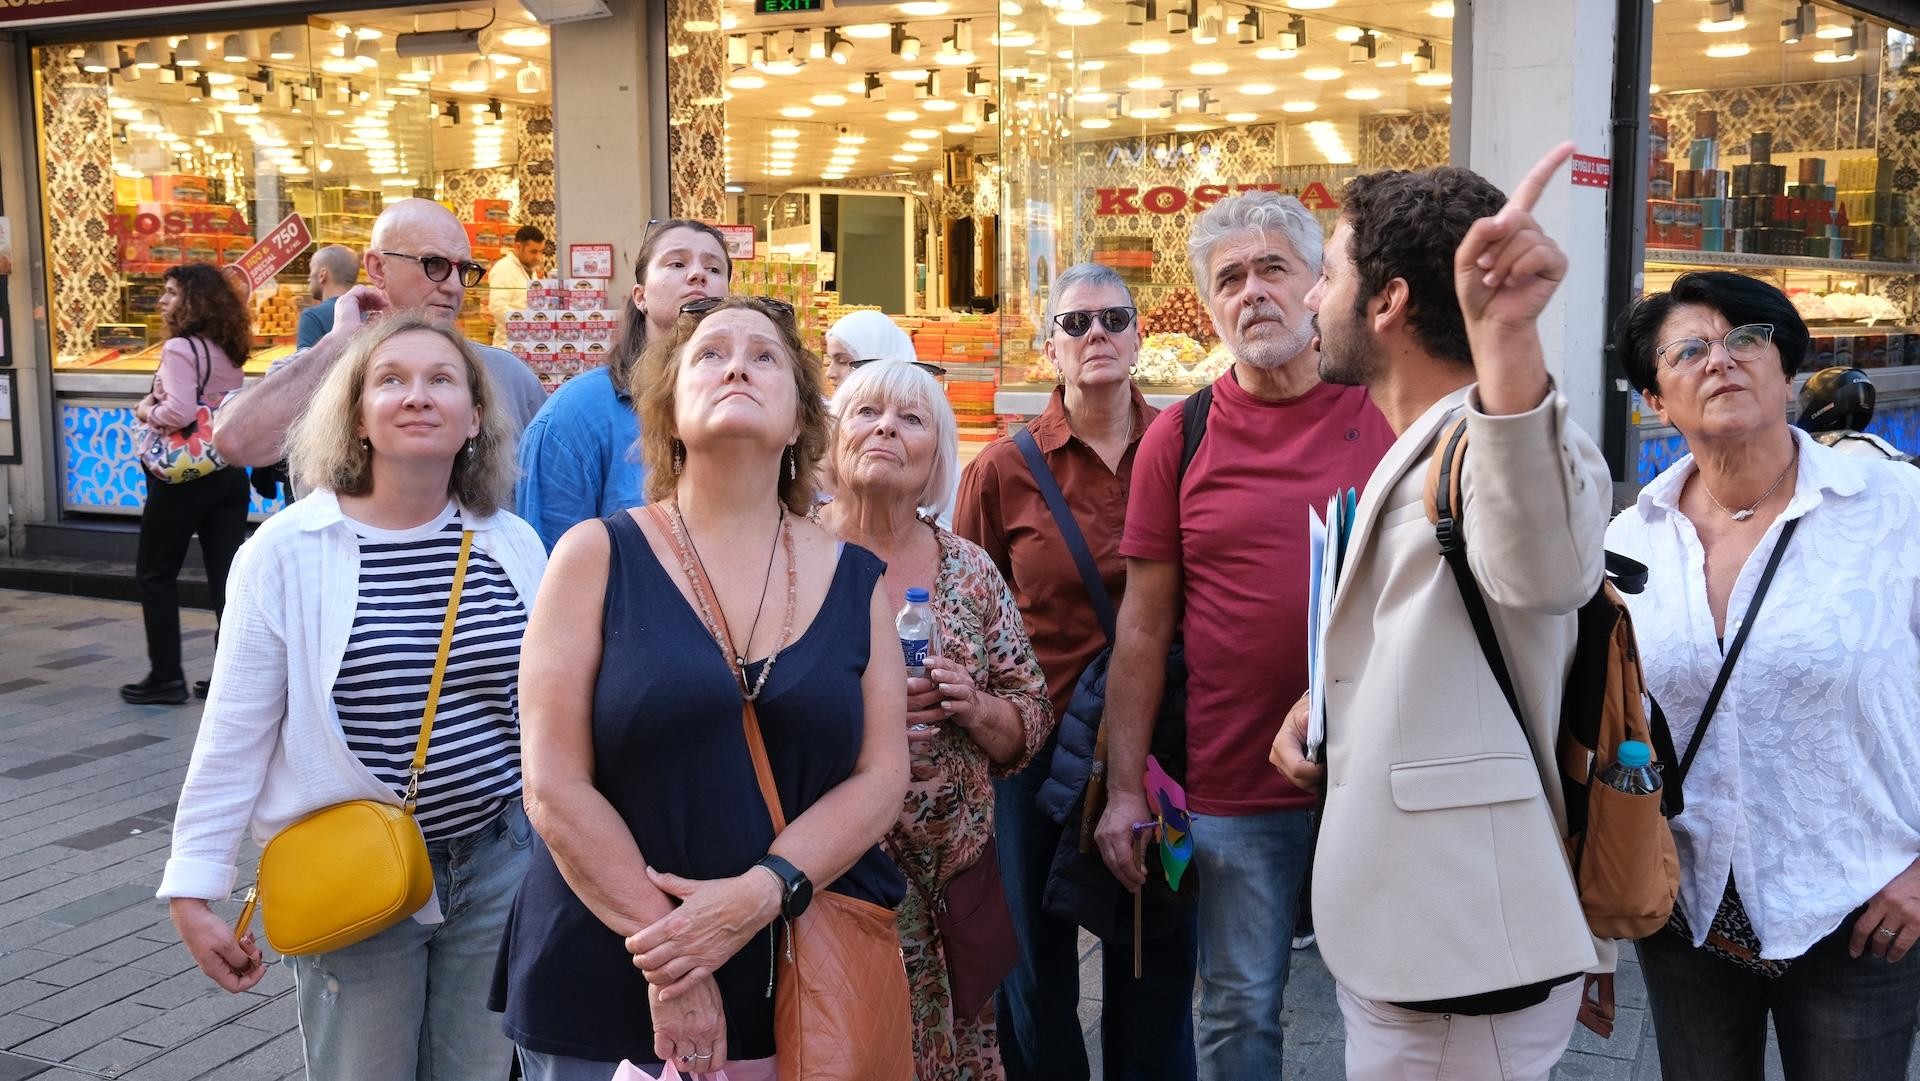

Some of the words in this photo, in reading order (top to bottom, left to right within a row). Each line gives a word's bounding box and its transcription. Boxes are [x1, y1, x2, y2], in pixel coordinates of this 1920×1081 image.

[765, 0, 811, 12] EXIT
[1096, 182, 1341, 215] KOSA
[104, 212, 249, 236] KOSKA
[271, 222, 299, 250] 750
[250, 253, 277, 278] SPECIAL
[254, 264, 276, 285] OFFER
